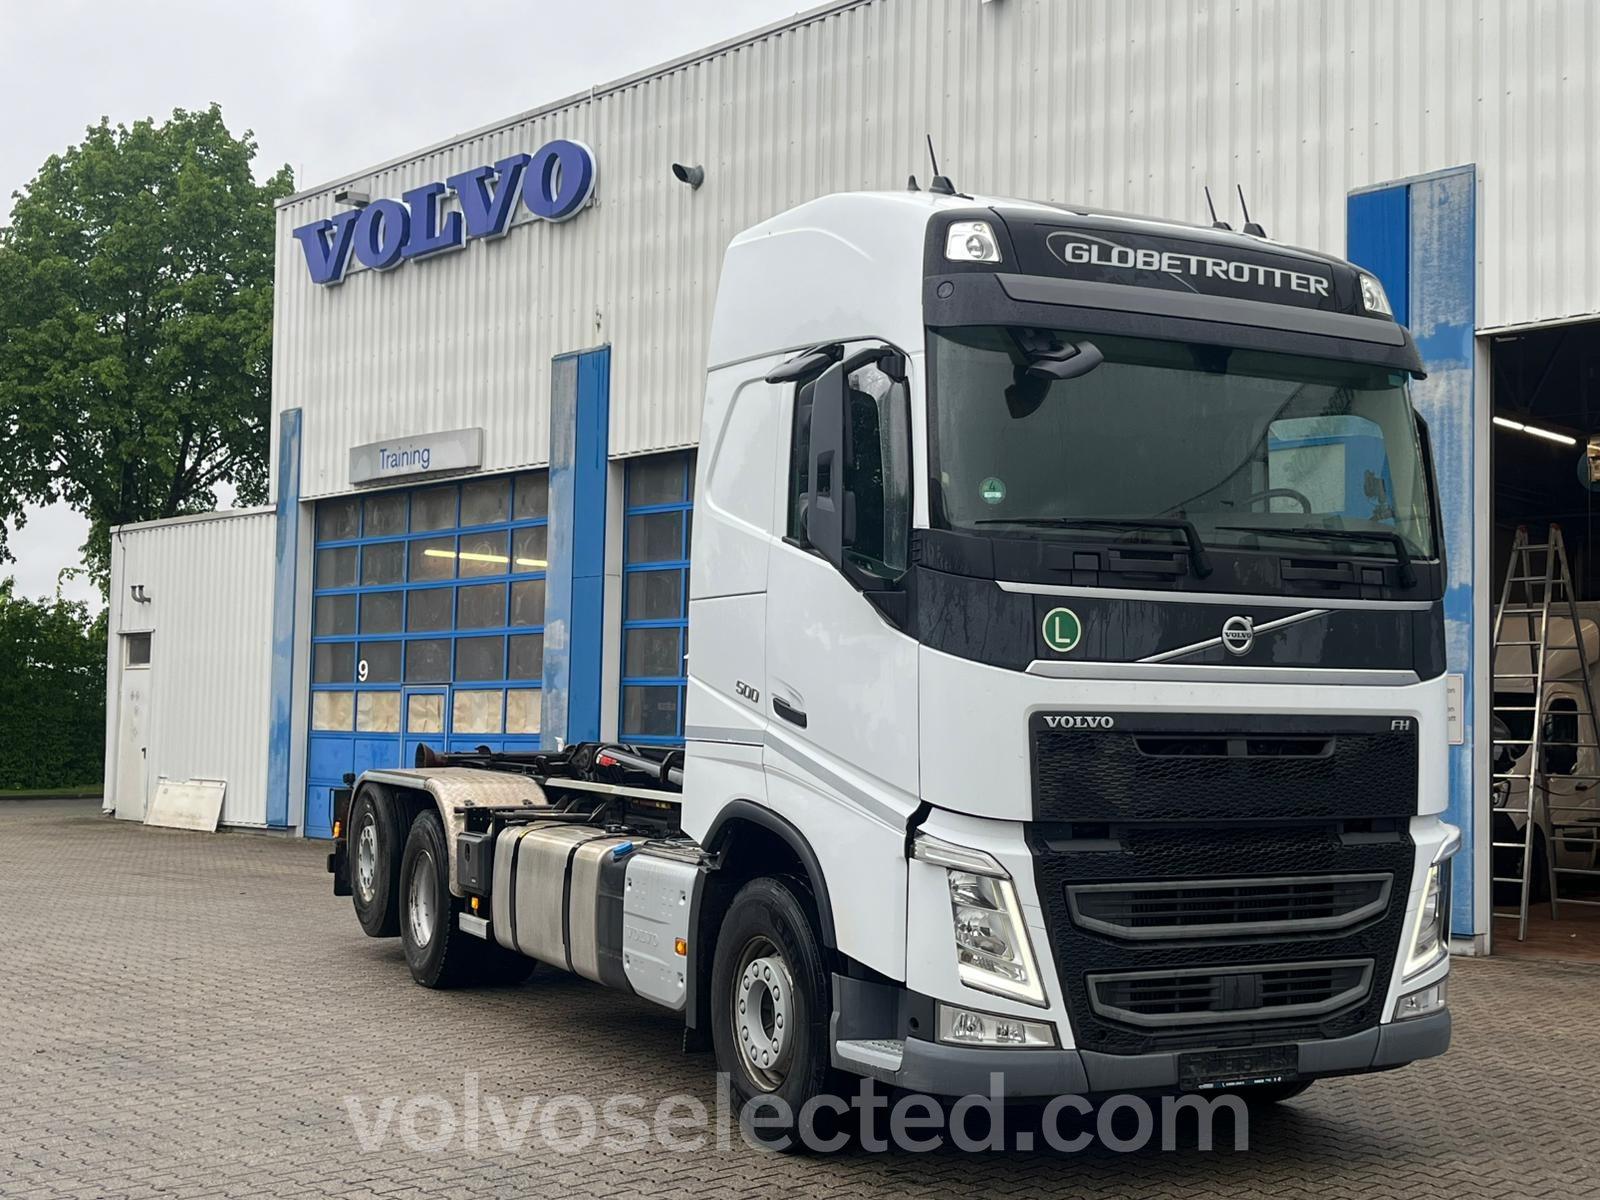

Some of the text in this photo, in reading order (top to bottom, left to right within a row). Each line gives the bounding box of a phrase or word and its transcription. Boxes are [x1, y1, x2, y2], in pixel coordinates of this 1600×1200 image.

[293, 139, 595, 285] VOLVO
[1064, 242, 1329, 297] GLOBETROTTER
[380, 444, 431, 469] Training
[1055, 616, 1071, 643] L
[358, 660, 369, 682] 9
[736, 680, 760, 703] 500
[1043, 715, 1114, 728] VOLVO
[1391, 719, 1410, 731] FH
